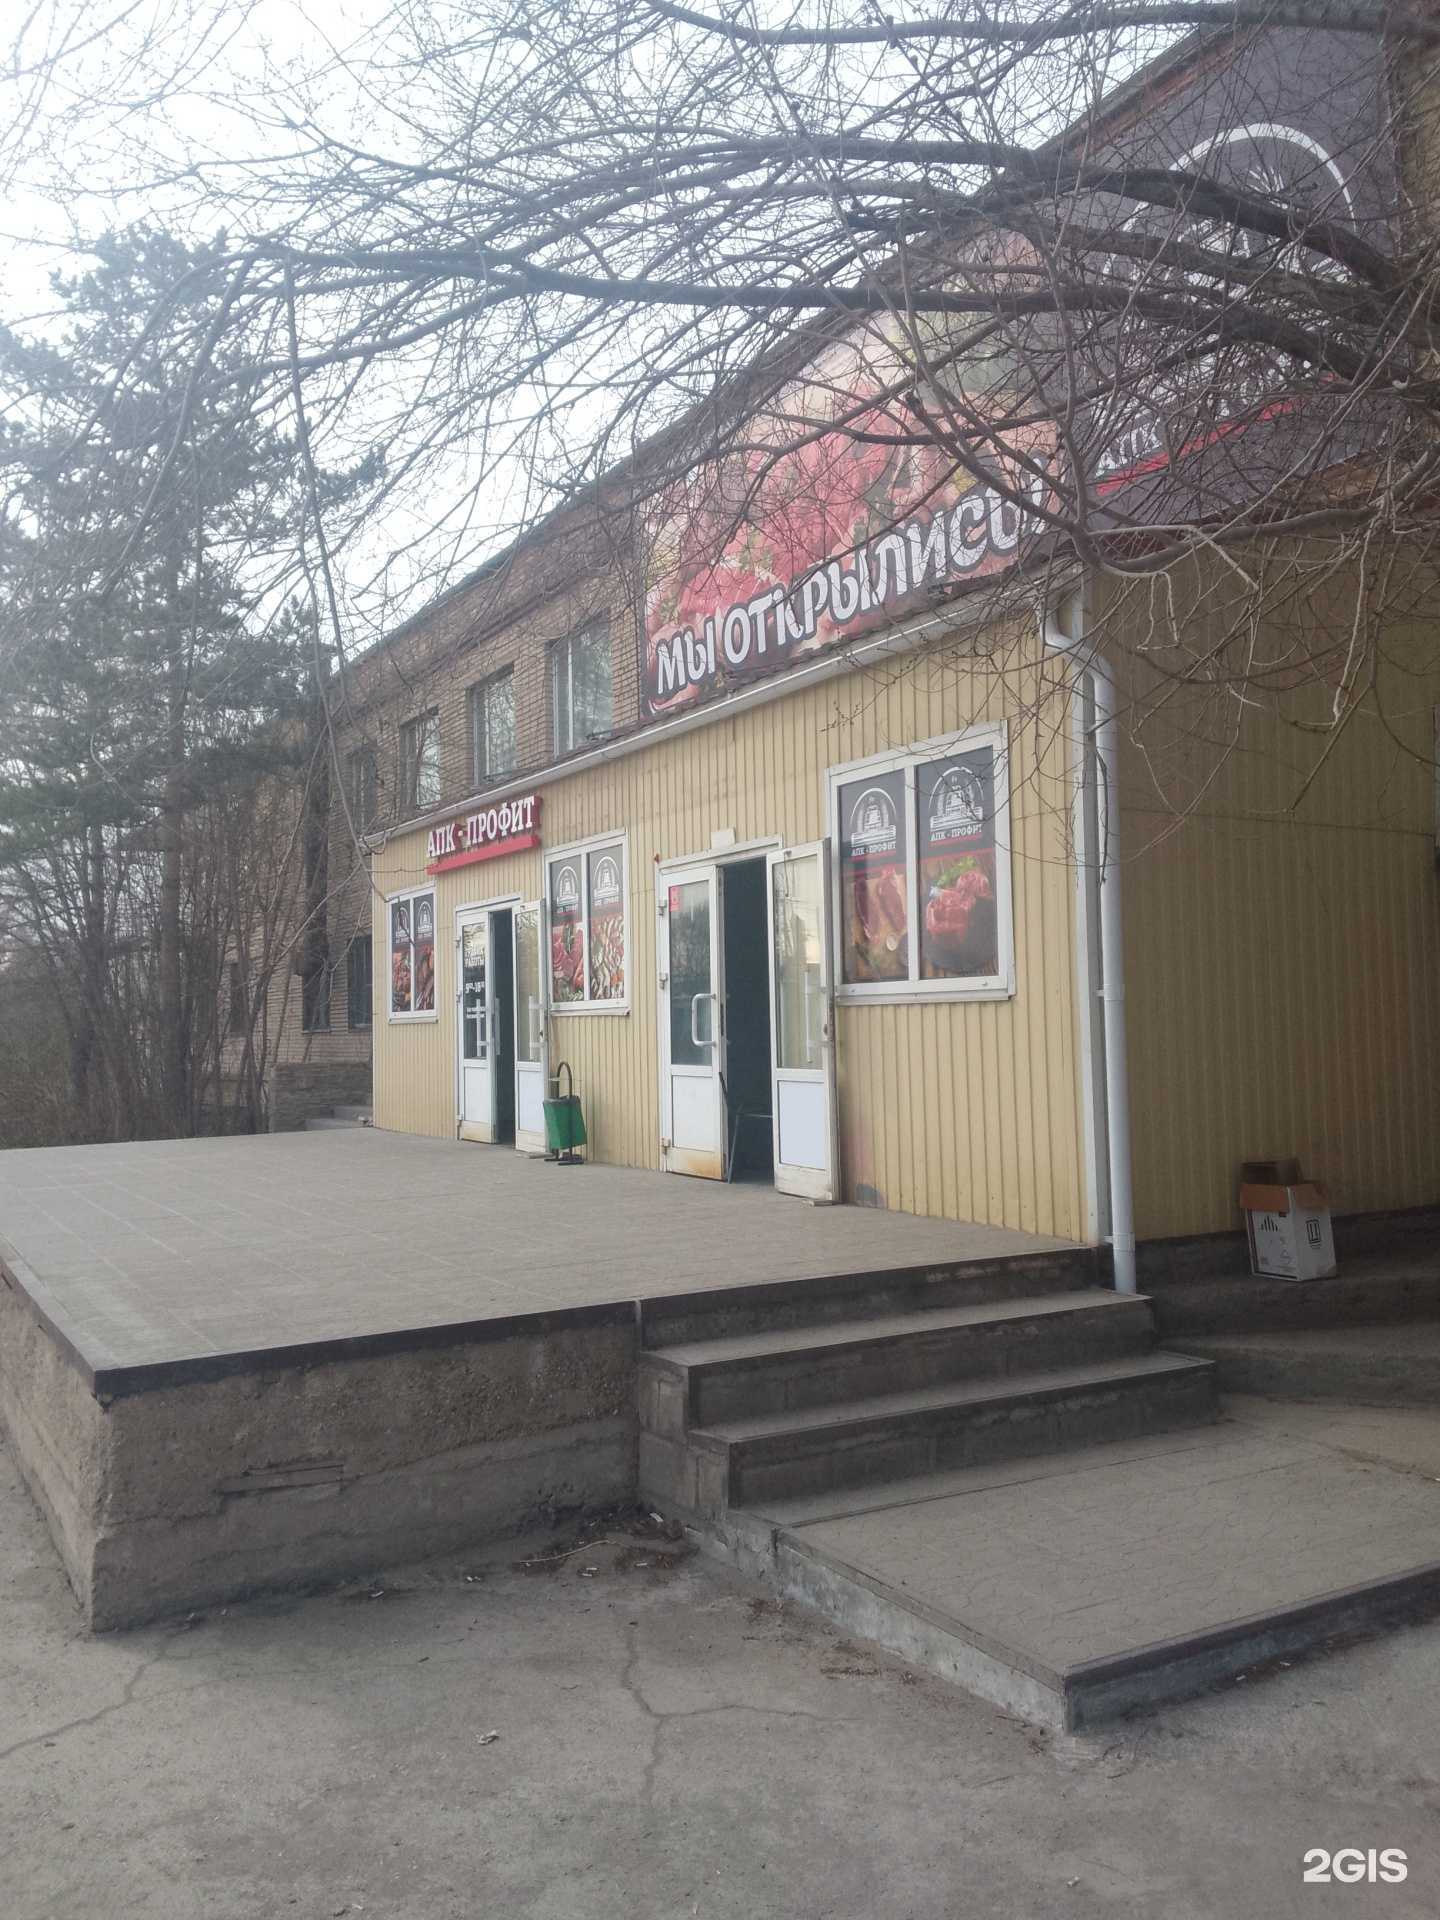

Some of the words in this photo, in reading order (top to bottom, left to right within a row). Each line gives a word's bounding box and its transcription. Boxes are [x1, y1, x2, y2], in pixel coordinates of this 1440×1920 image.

[657, 620, 716, 695] МЫ
[427, 823, 456, 858] АПК
[466, 796, 534, 846] ПРОФИТ
